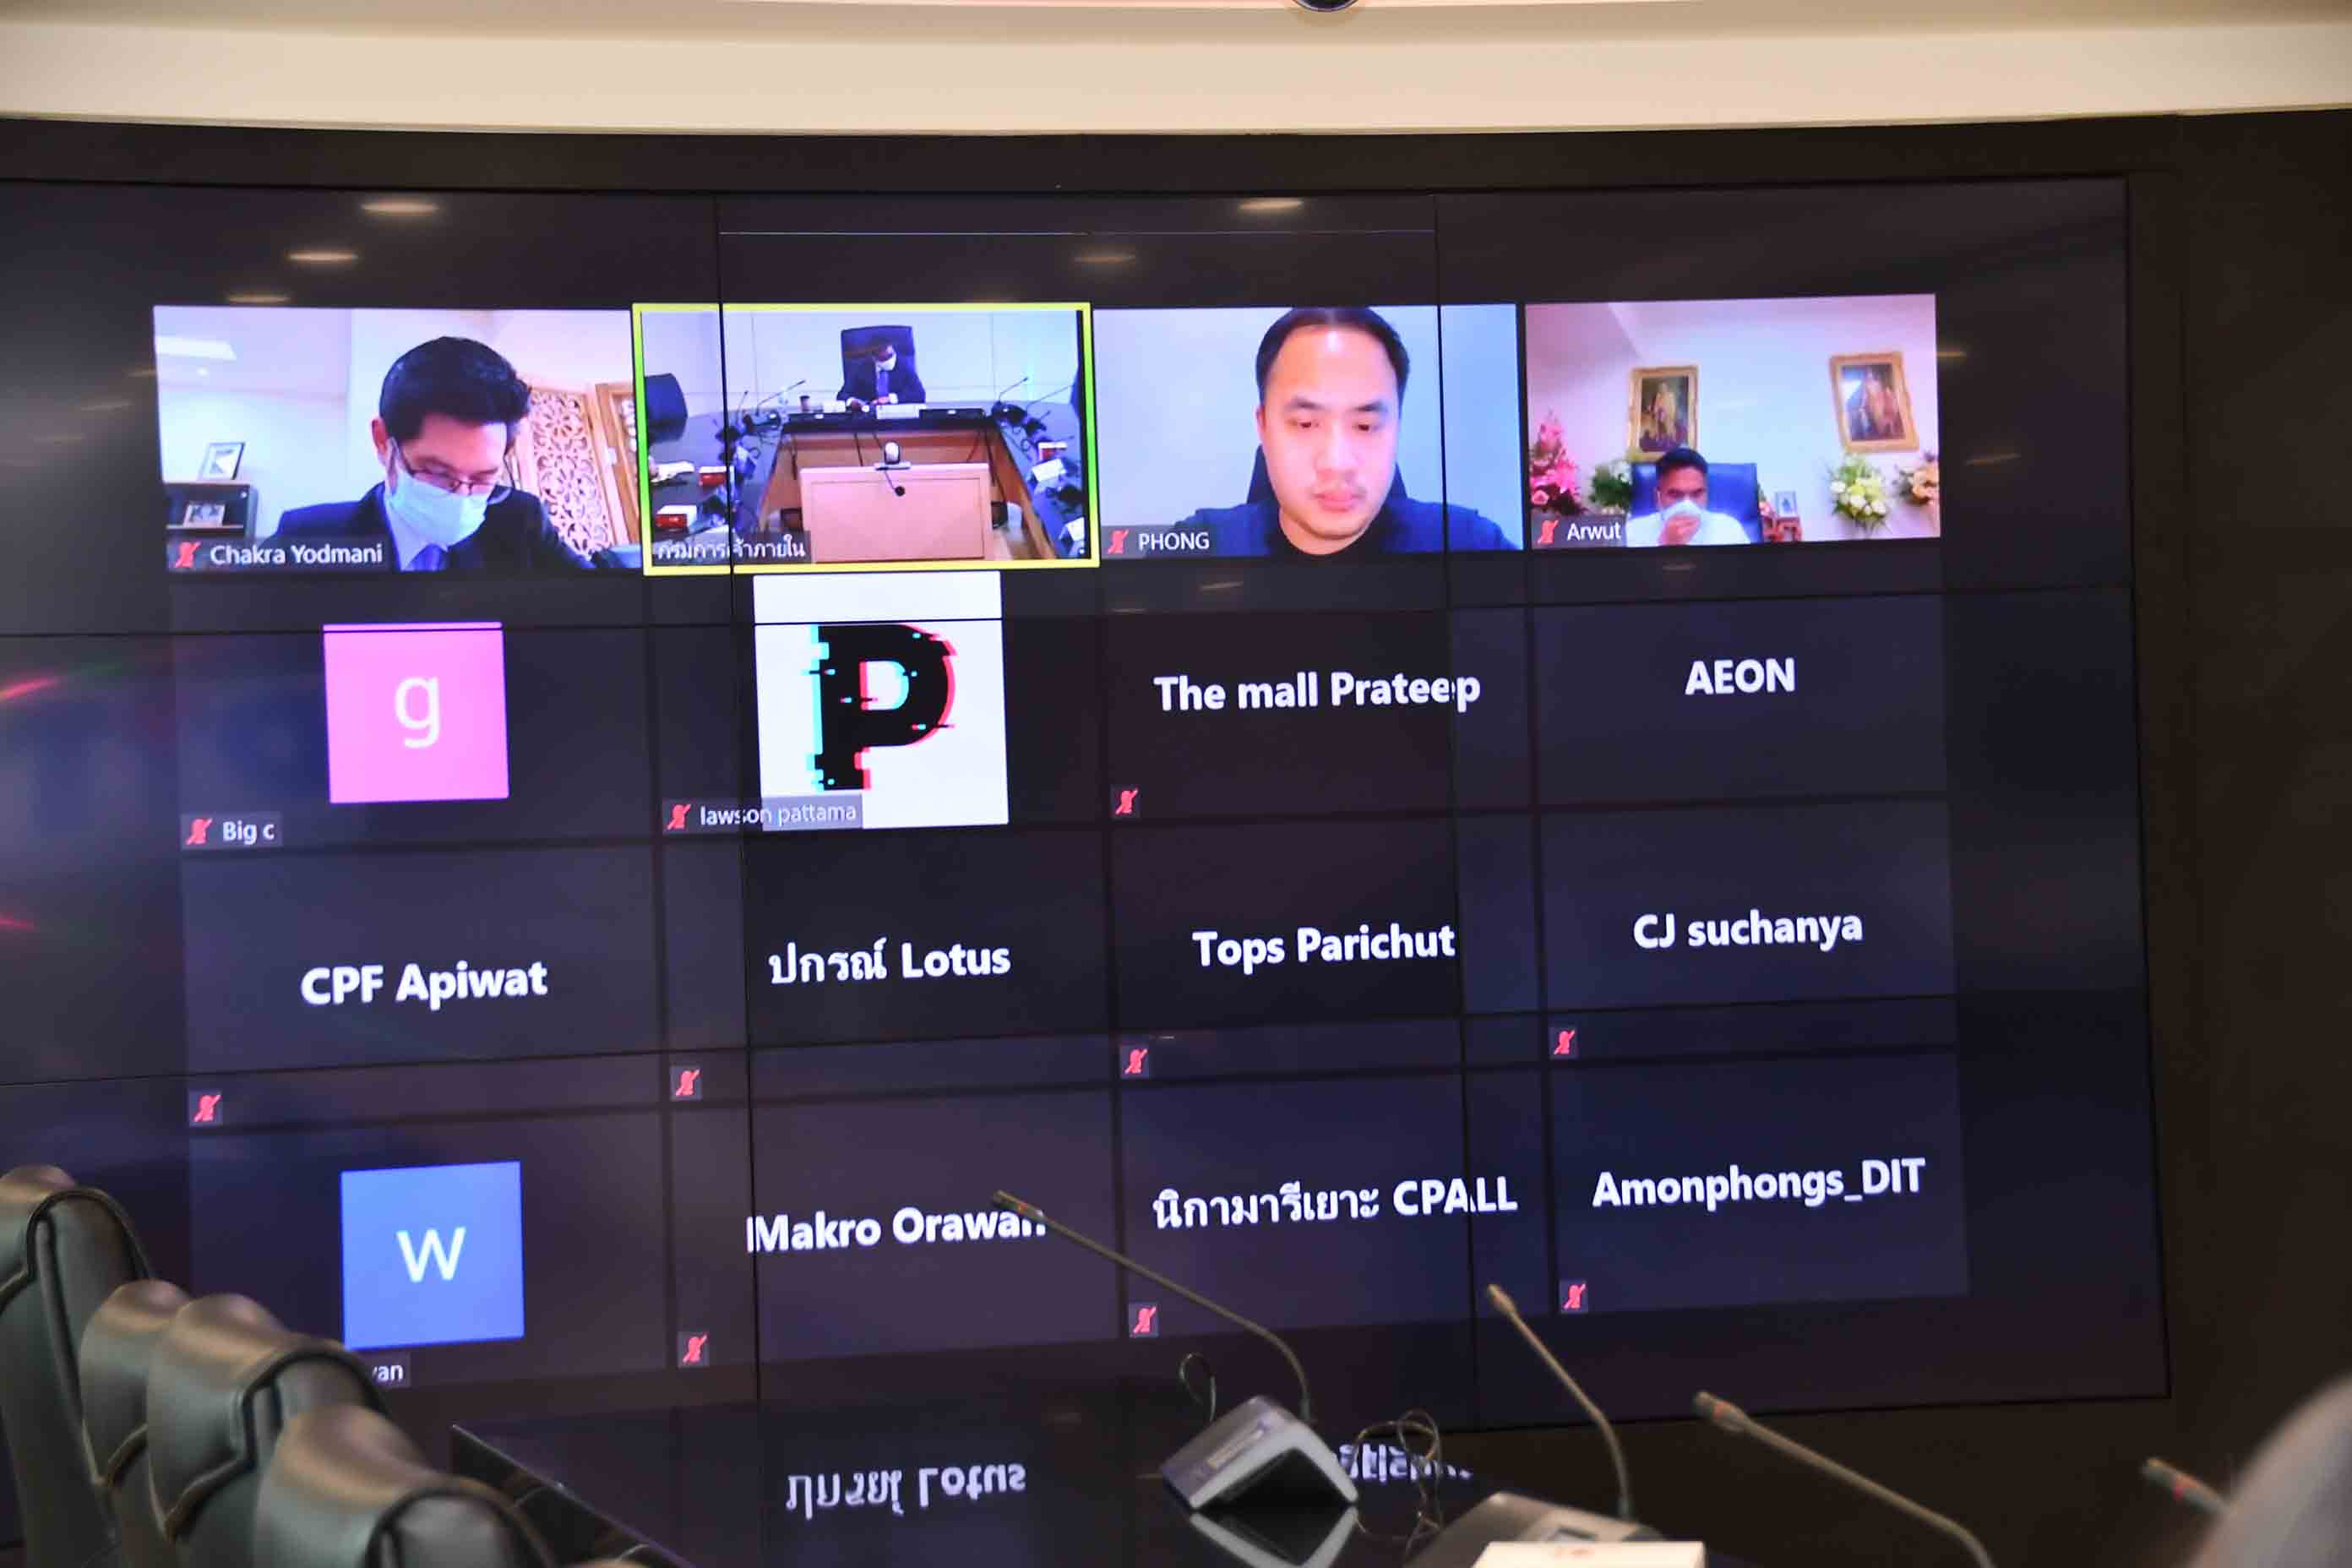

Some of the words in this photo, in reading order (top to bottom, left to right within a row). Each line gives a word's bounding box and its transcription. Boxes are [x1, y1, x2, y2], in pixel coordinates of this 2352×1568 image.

[210, 544, 286, 564] Chakra
[291, 543, 383, 564] Yodmani
[1138, 531, 1210, 551] PHONG
[1566, 521, 1622, 542] Arwut
[1153, 675, 1227, 711] The
[1238, 671, 1319, 710] mall
[1331, 670, 1481, 713] Prateep
[1685, 658, 1795, 695] AEON
[394, 676, 442, 749] g
[805, 623, 956, 792] P
[222, 819, 258, 846] Big
[262, 824, 275, 841] c
[700, 803, 772, 825] lawson
[778, 803, 857, 827] pattama
[1192, 931, 1286, 976] Tops
[1297, 923, 1456, 963] Parichut
[1633, 913, 1675, 950] CJ
[1687, 908, 1863, 952] suchanya
[768, 937, 888, 984] ปกรณ์
[901, 942, 1011, 979] Lotus
[301, 964, 384, 1005] CPF
[395, 960, 548, 1011] Apiwat
[1152, 1181, 1380, 1229] นิกามารีเยาะ
[1393, 1175, 1518, 1216] CPALL
[1592, 1157, 1926, 1212] Amonphongs_DIT
[746, 1211, 882, 1253] Makro
[396, 1227, 466, 1283] W
